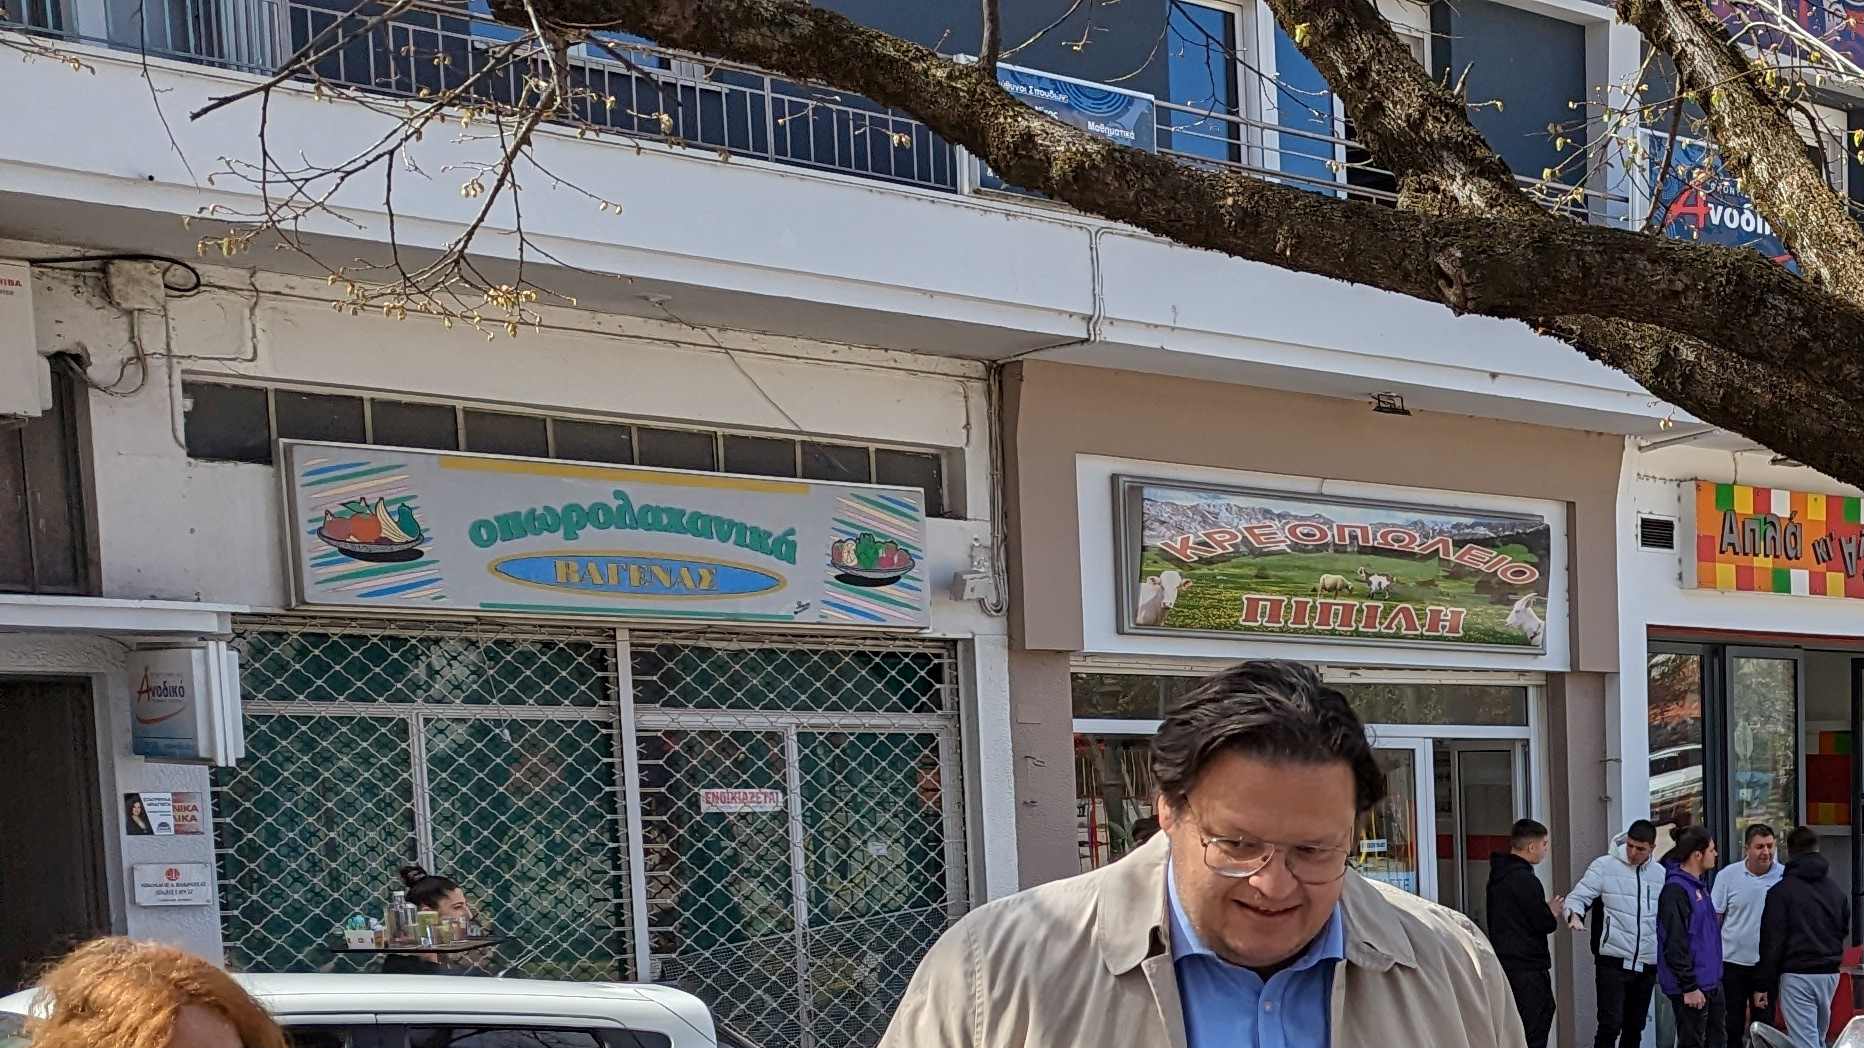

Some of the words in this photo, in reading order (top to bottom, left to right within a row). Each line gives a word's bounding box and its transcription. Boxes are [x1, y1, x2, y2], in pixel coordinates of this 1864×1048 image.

[1087, 121, 1136, 140] Μαθηματικά
[469, 489, 797, 566] οπωρολαχανικά
[1719, 509, 1803, 561] Απλά
[553, 558, 719, 591] ΒΑΓΕΝΑΣ
[1159, 521, 1540, 586] ΚΡΕΟΠΩΛΕΙΟ
[1240, 594, 1467, 637] ΠΙΠΙΛΗ
[704, 791, 779, 804] ΕΝΟΙΚΙΑΖΕΤΑΙ
